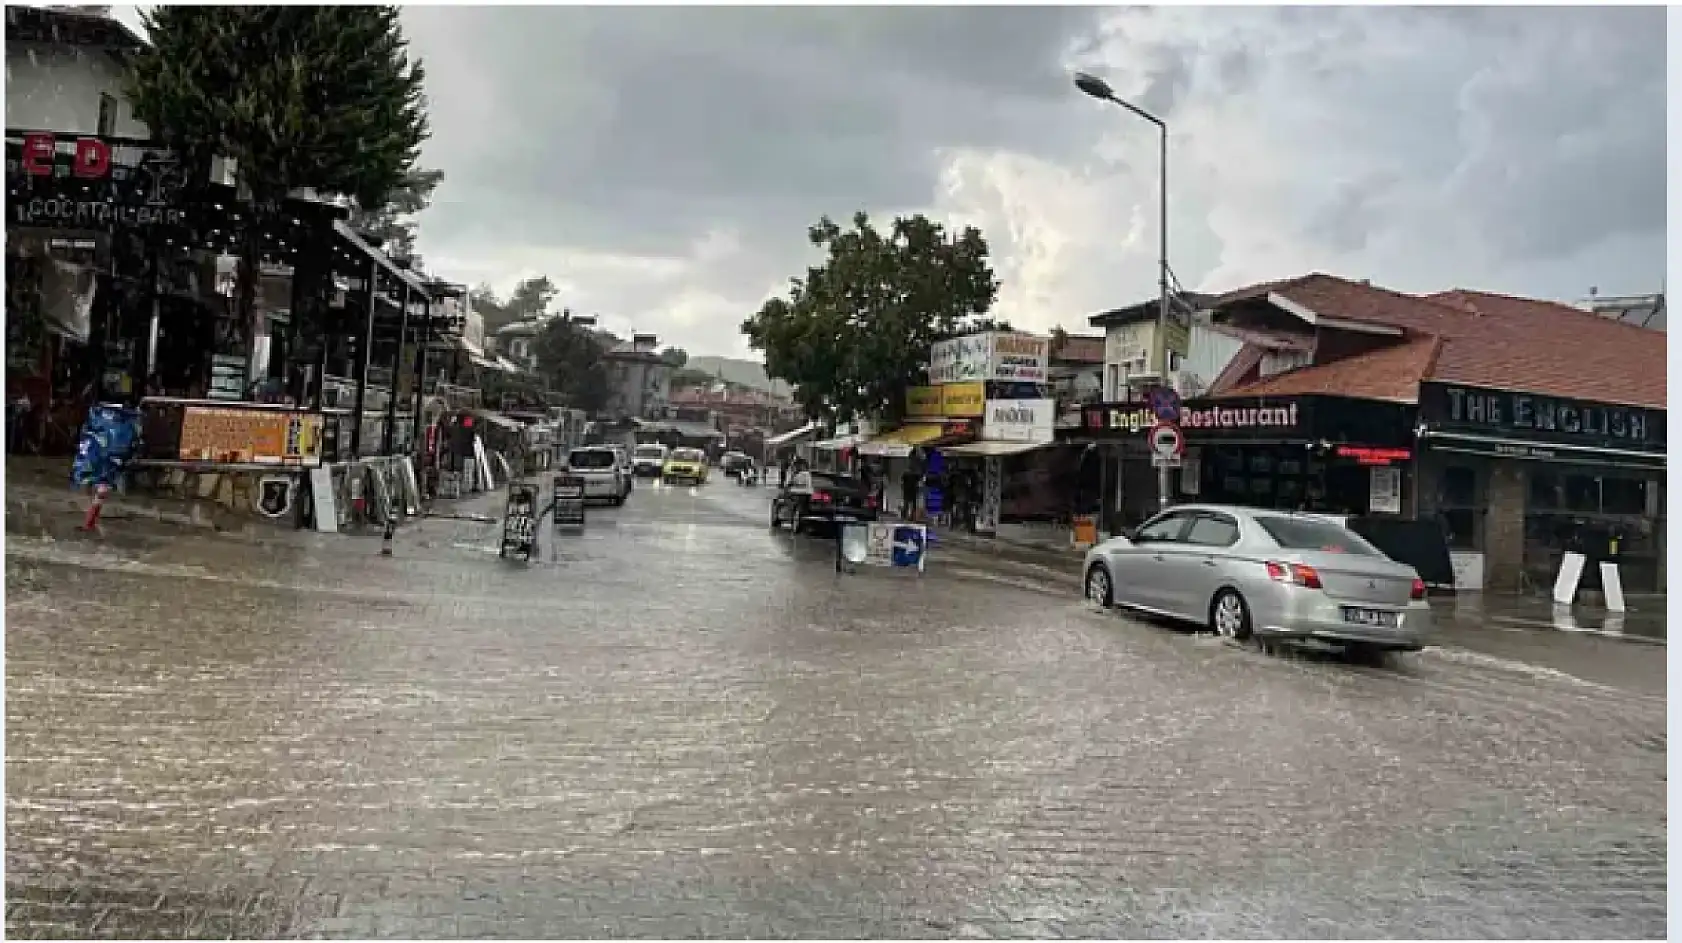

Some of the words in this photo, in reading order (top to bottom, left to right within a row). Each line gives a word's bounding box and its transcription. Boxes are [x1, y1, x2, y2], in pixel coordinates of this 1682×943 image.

[1179, 402, 1298, 428] Restaurant
[1446, 387, 1502, 424] THE
[1512, 395, 1647, 440] ENGLISH
